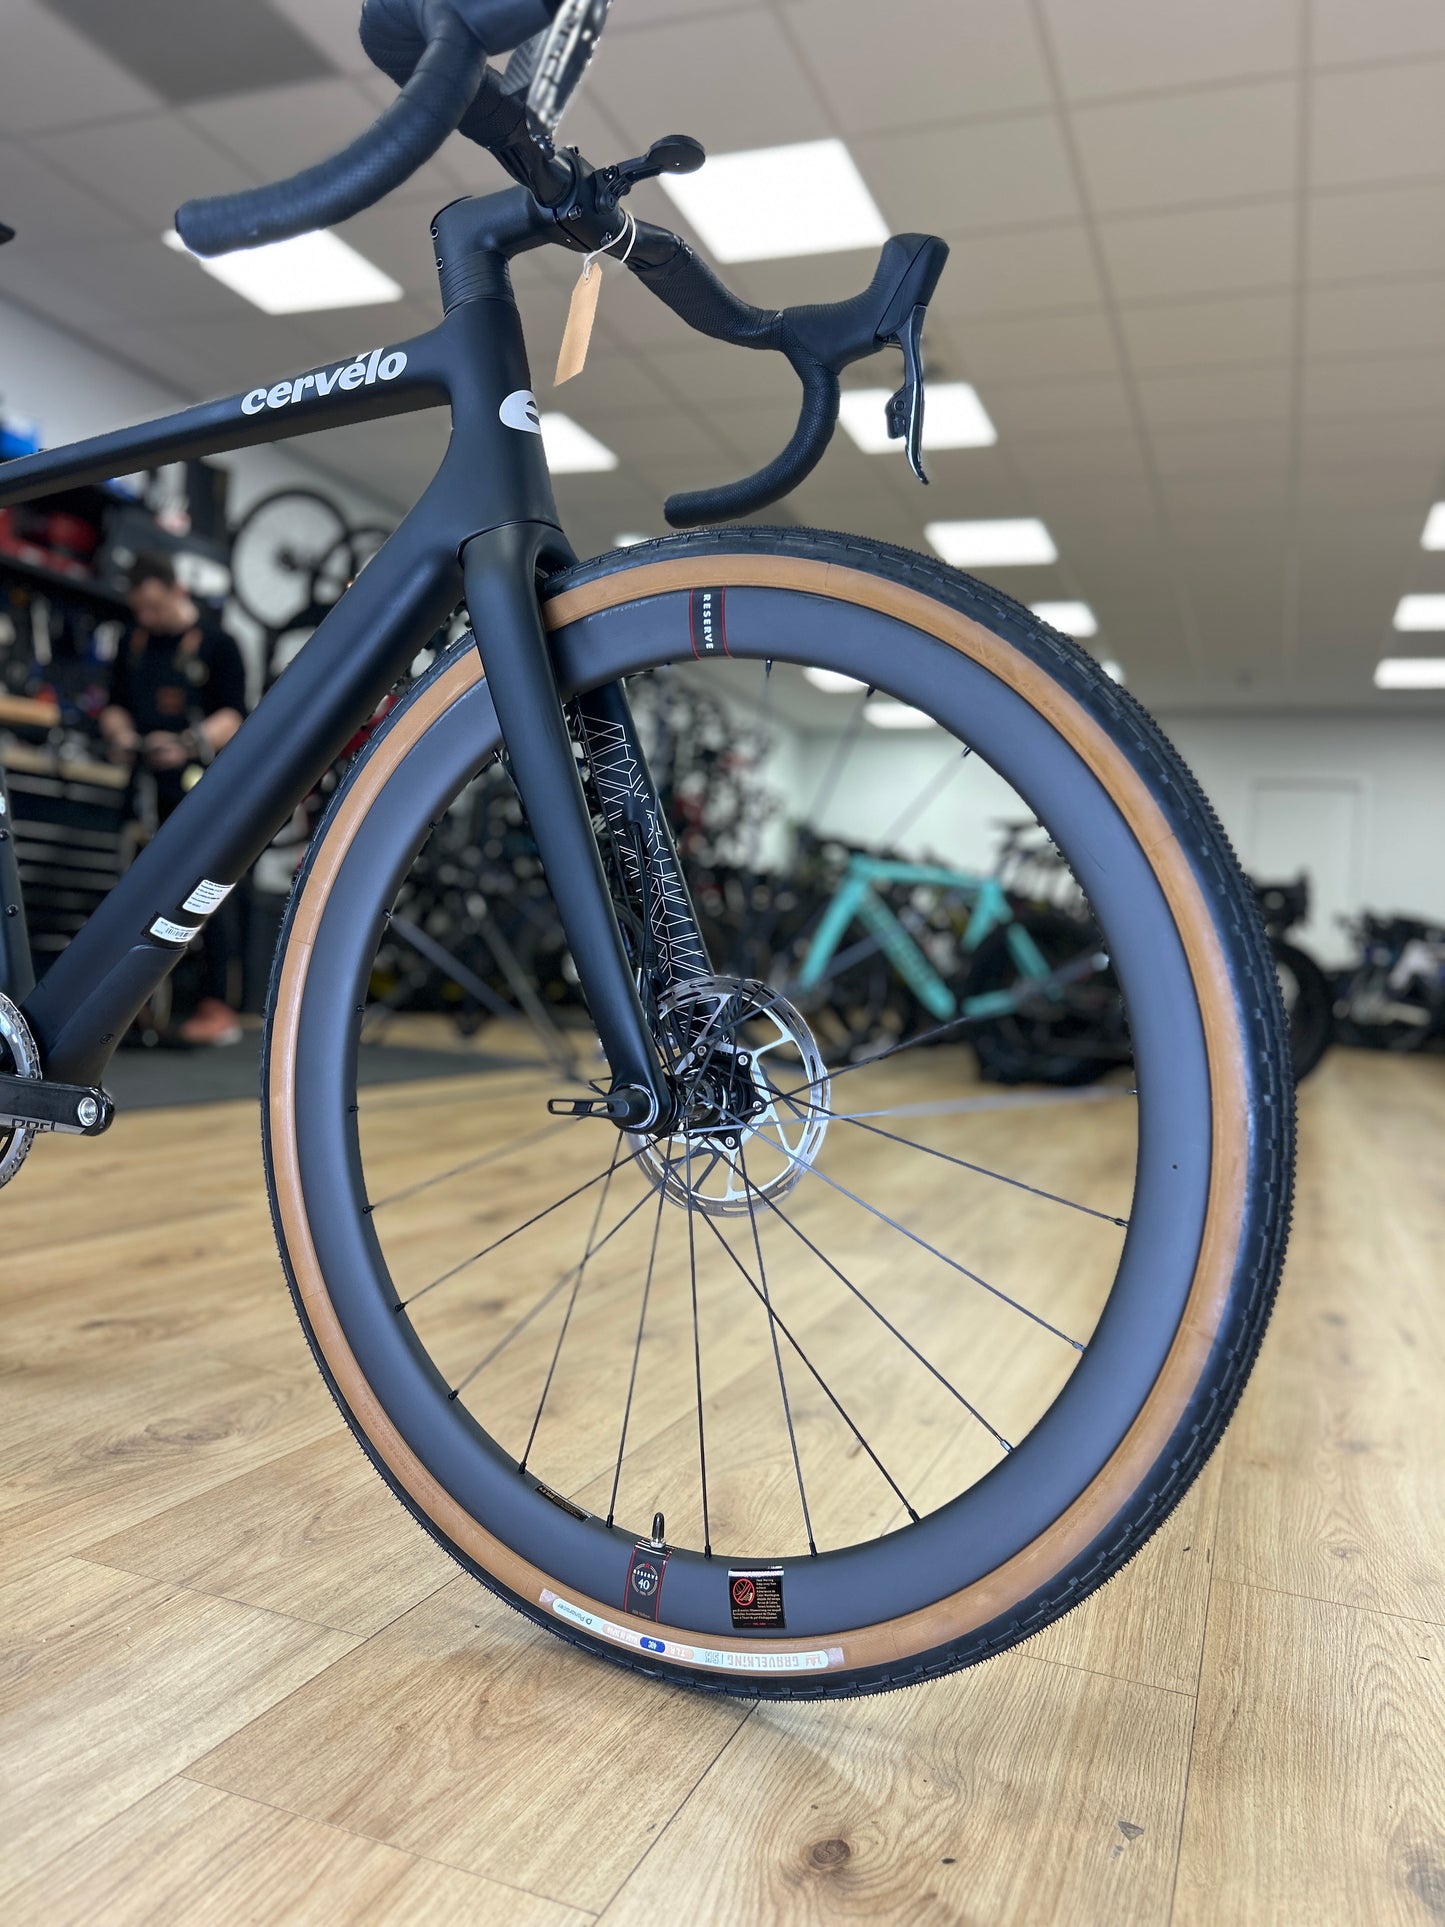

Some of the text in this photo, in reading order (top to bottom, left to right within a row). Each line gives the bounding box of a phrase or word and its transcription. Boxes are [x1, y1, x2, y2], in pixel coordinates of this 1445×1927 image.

[240, 347, 408, 416] cervélo
[702, 593, 714, 650] RESERVE
[638, 1578, 650, 1590] 40
[557, 1603, 585, 1622] Panaracer
[670, 1646, 686, 1657] TLR
[727, 1654, 799, 1668] GRAVELKING
